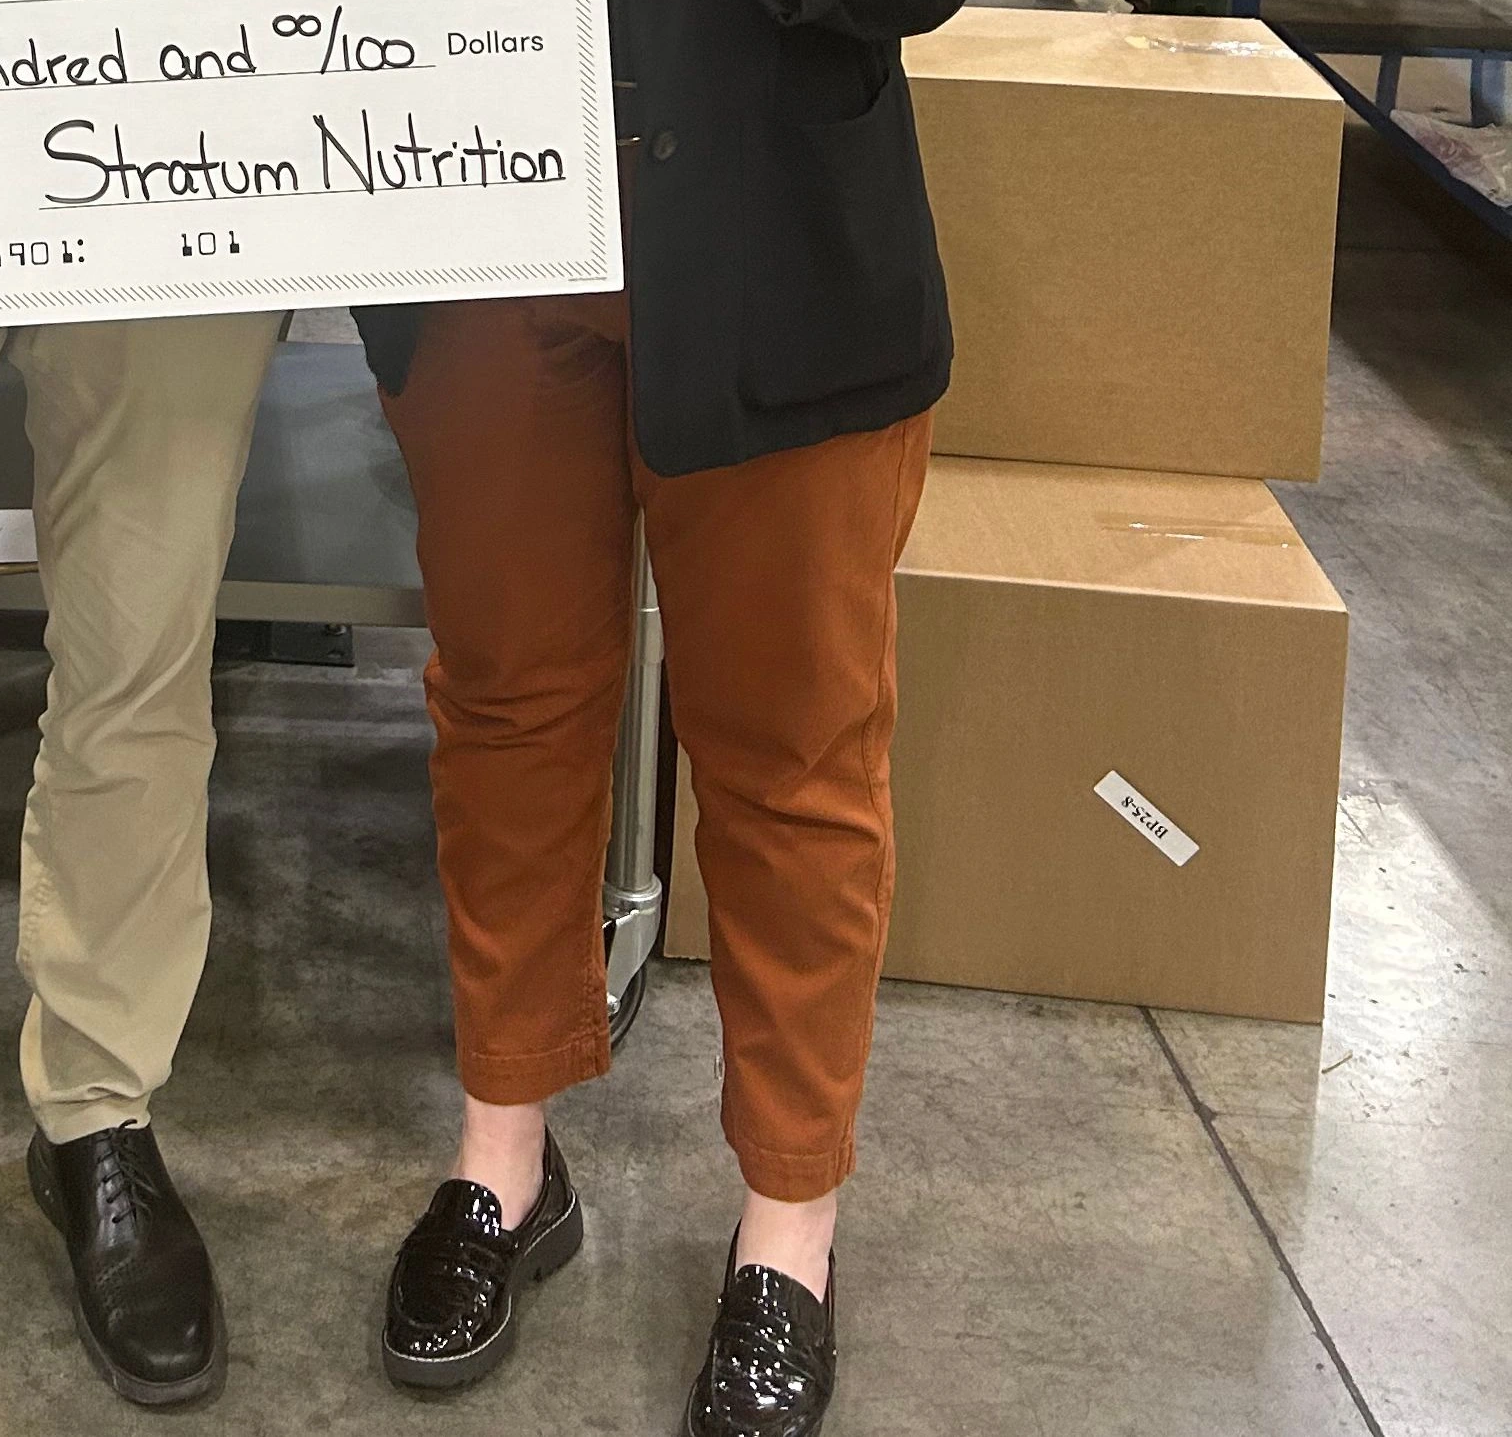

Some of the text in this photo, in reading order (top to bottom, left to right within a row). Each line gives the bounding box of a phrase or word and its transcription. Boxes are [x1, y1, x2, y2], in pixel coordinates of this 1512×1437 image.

[159, 24, 257, 81] and
[447, 30, 544, 56] Dollars
[43, 108, 566, 205] Stratum Nutrition
[1120, 795, 1169, 839] BP25-8
